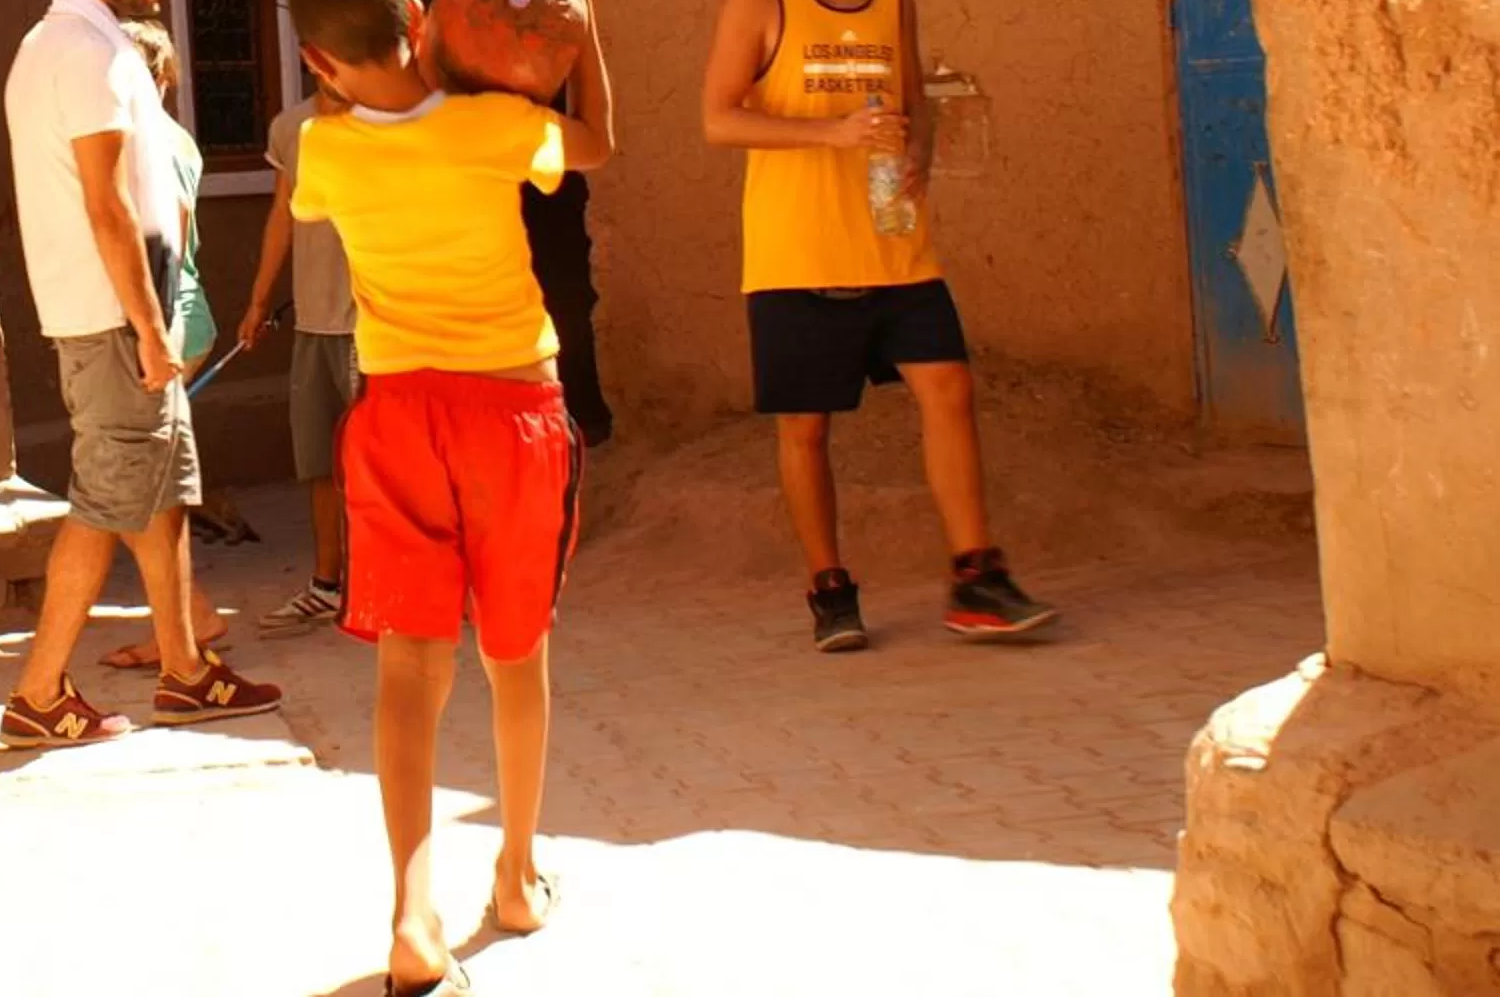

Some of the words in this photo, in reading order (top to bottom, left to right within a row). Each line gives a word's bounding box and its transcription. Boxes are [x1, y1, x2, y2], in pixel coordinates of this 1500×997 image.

[803, 44, 832, 59] LOS
[834, 44, 895, 61] ANGELES
[205, 680, 237, 706] N
[54, 712, 88, 740] N
